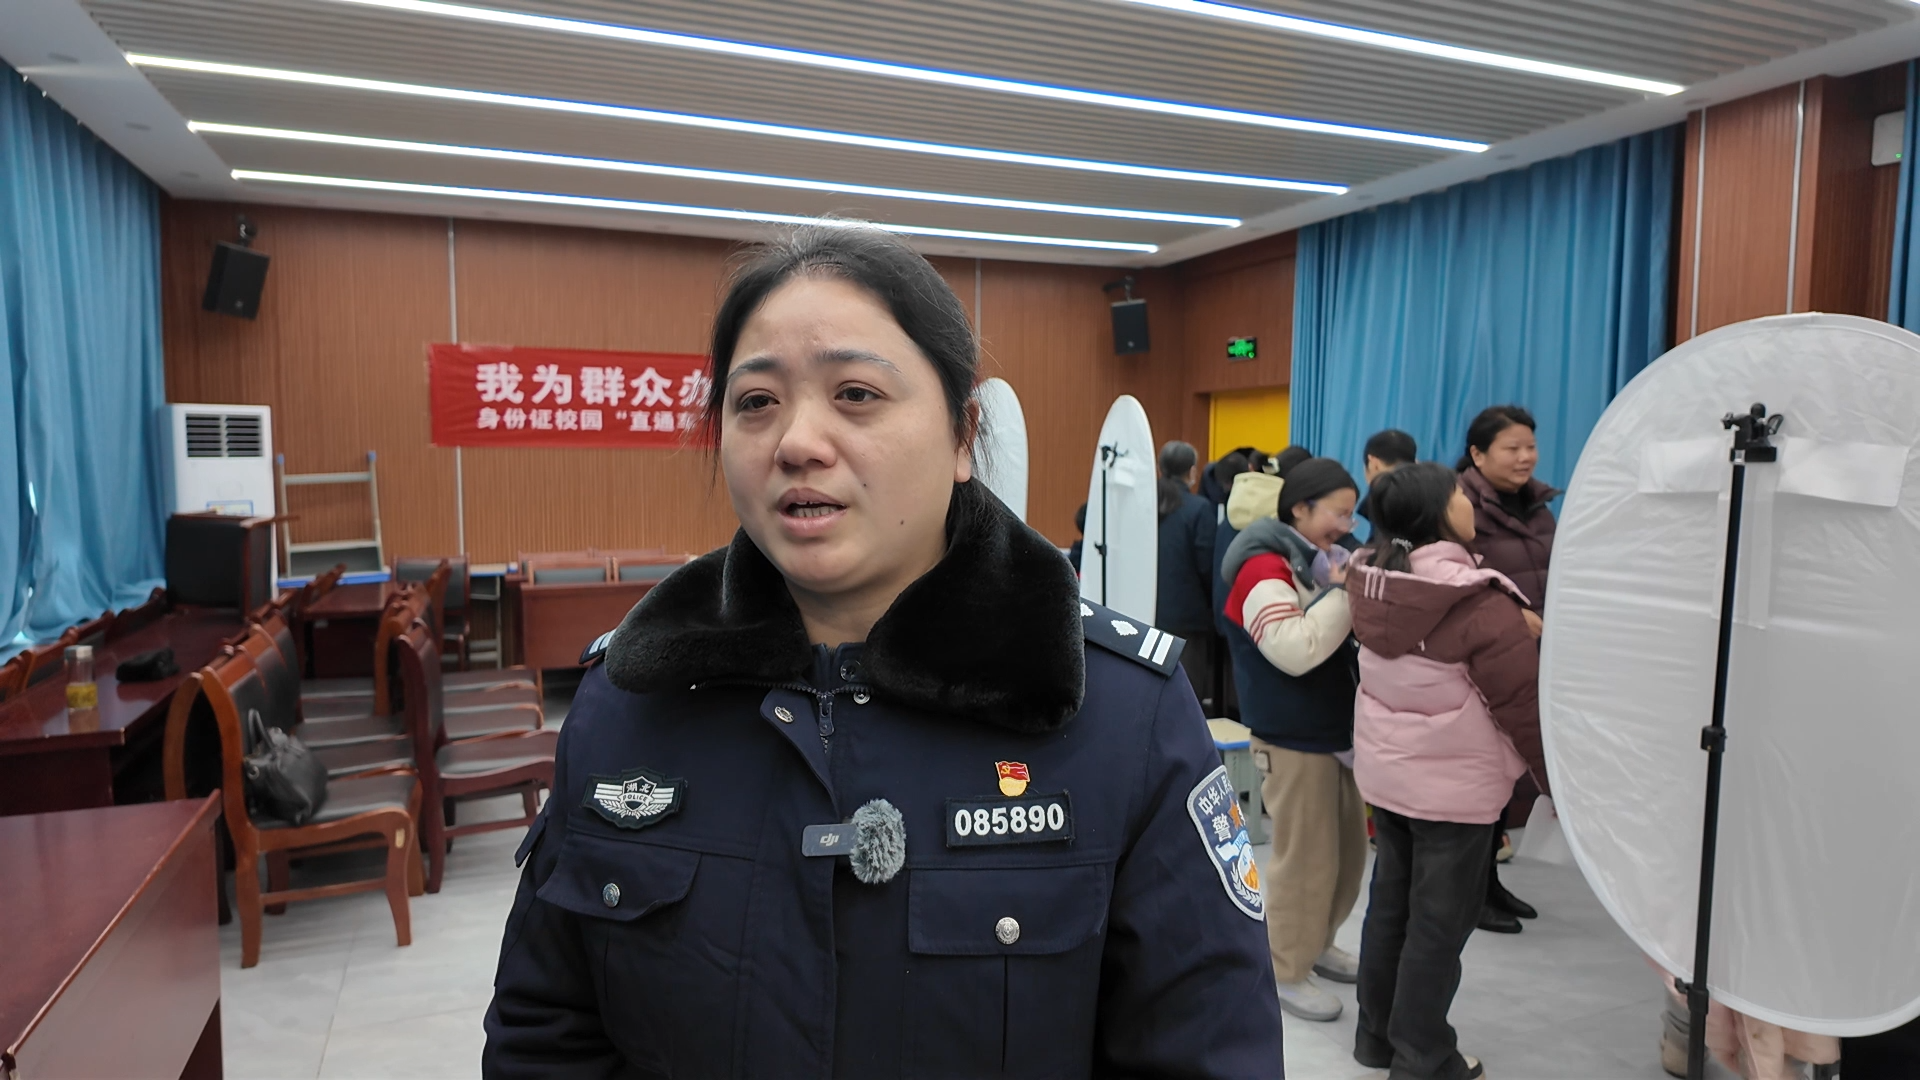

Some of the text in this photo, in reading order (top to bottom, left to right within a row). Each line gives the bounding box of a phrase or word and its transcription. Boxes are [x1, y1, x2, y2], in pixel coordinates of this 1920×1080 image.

[626, 782, 651, 794] 湖北
[622, 794, 648, 802] POLICE
[954, 803, 1065, 836] 085890
